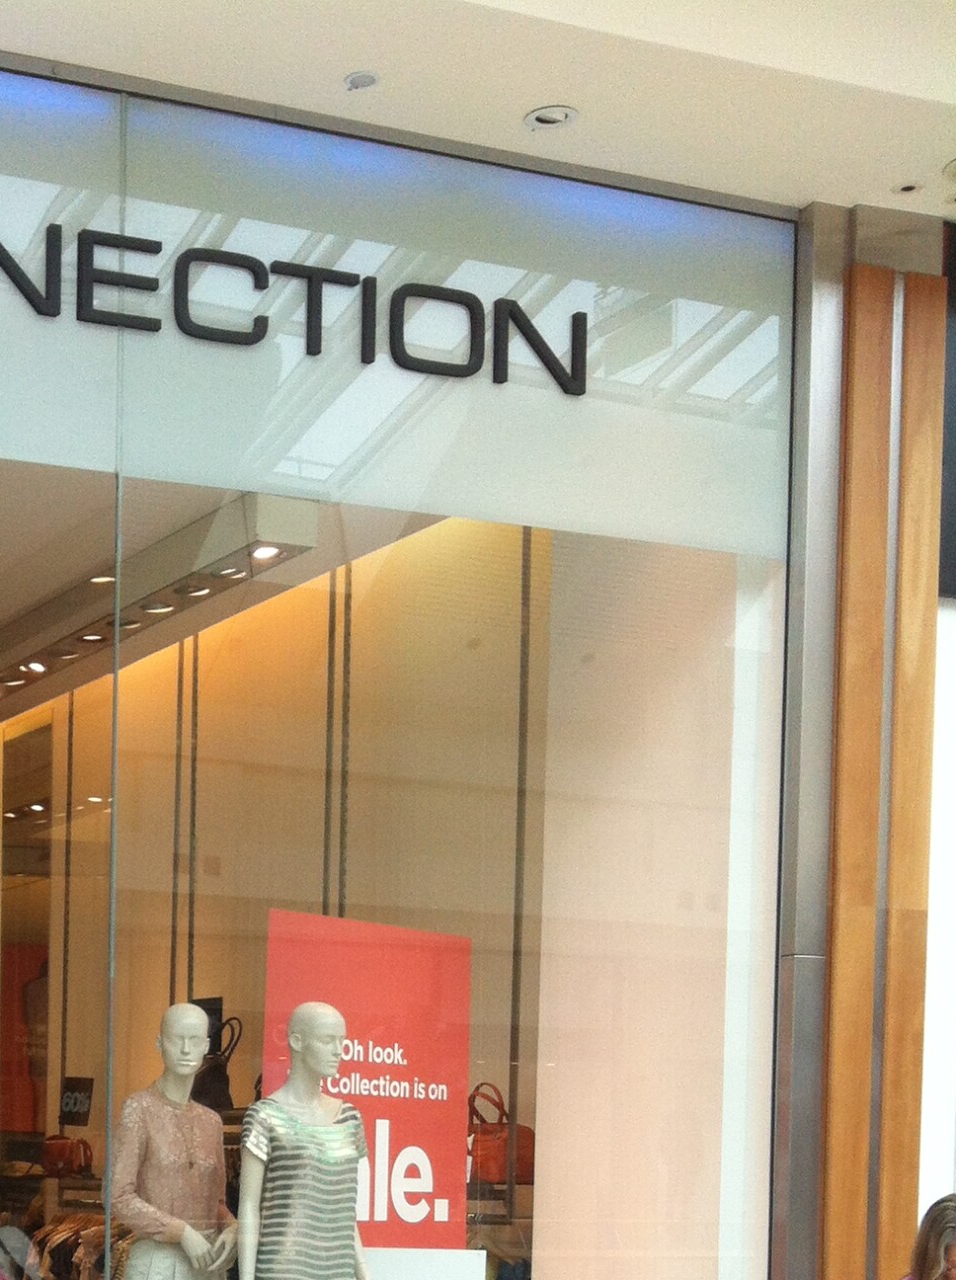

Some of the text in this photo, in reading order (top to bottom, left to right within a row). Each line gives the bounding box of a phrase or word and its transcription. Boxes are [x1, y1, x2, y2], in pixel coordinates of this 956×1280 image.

[342, 1039, 407, 1065] Oh look.
[327, 1073, 410, 1098] Collection
[414, 1078, 425, 1100] is
[429, 1083, 448, 1101] on
